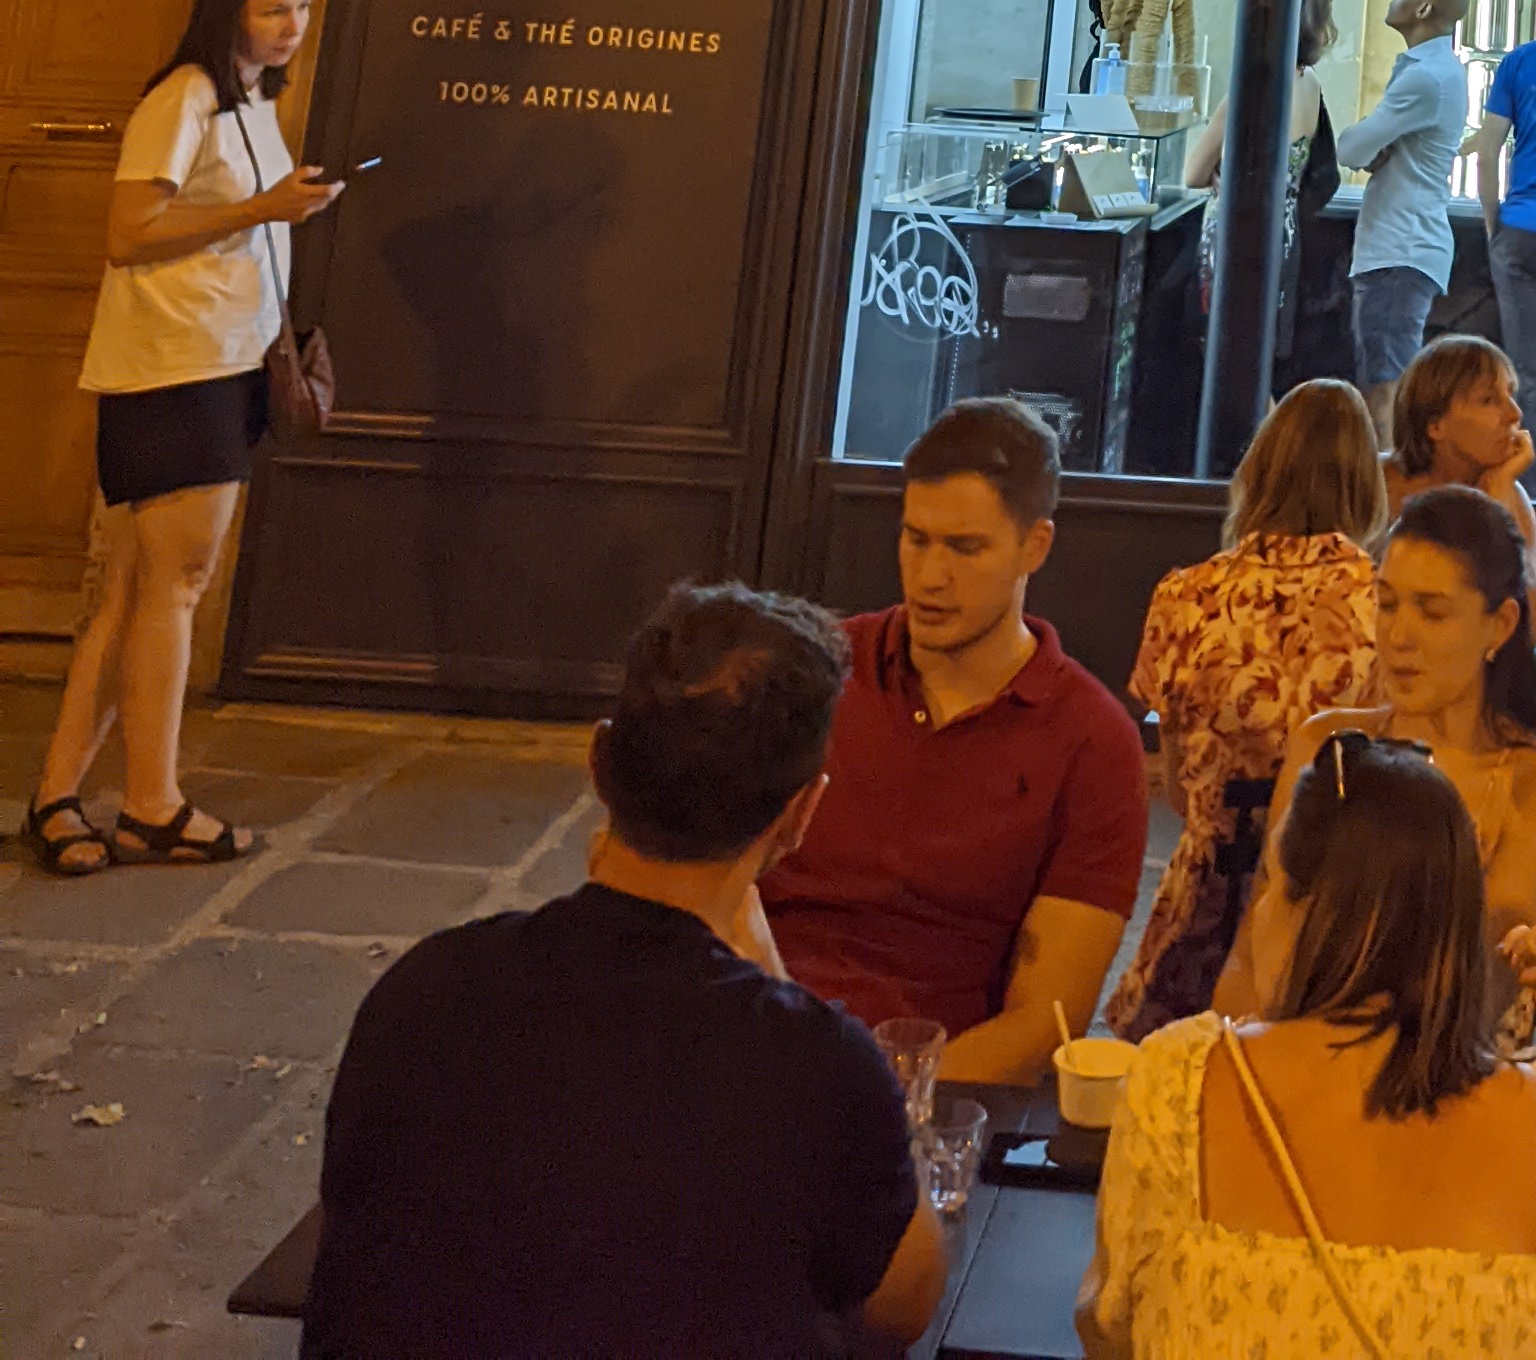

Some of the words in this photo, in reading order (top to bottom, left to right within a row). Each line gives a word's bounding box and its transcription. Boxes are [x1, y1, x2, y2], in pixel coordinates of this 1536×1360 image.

[411, 12, 484, 39] CAFÉ
[494, 20, 511, 41] &
[525, 18, 575, 45] THÉ
[588, 26, 721, 53] ORIGINES
[440, 81, 510, 104] 100%
[523, 86, 672, 114] ARTISANAL
